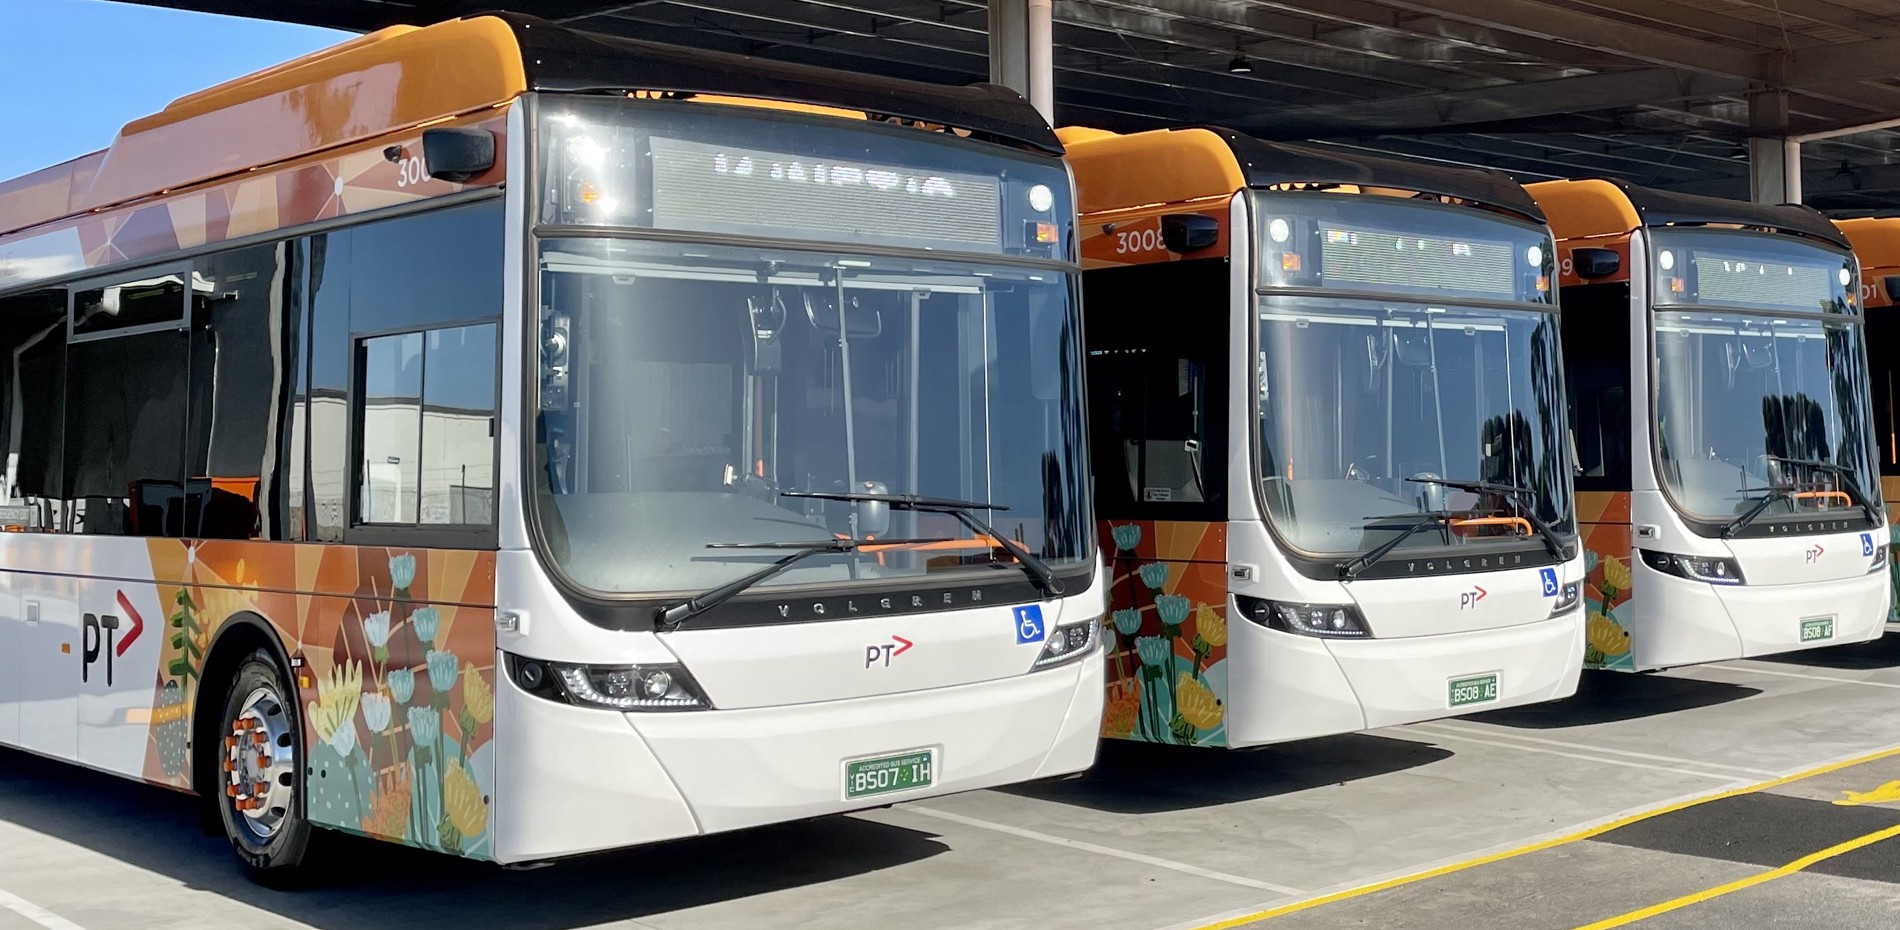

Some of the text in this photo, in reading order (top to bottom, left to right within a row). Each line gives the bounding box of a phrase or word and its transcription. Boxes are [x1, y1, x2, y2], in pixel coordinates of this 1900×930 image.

[1408, 555, 1521, 572] VOLGREN
[778, 589, 982, 618] VOLGREN
[1461, 592, 1477, 610] PT
[83, 613, 119, 688] PT
[865, 643, 895, 669] PT
[1454, 682, 1496, 703] BS08 AE
[858, 756, 921, 772] ACCREDITED BUS SERVICE
[855, 762, 931, 792] BS07 IH
